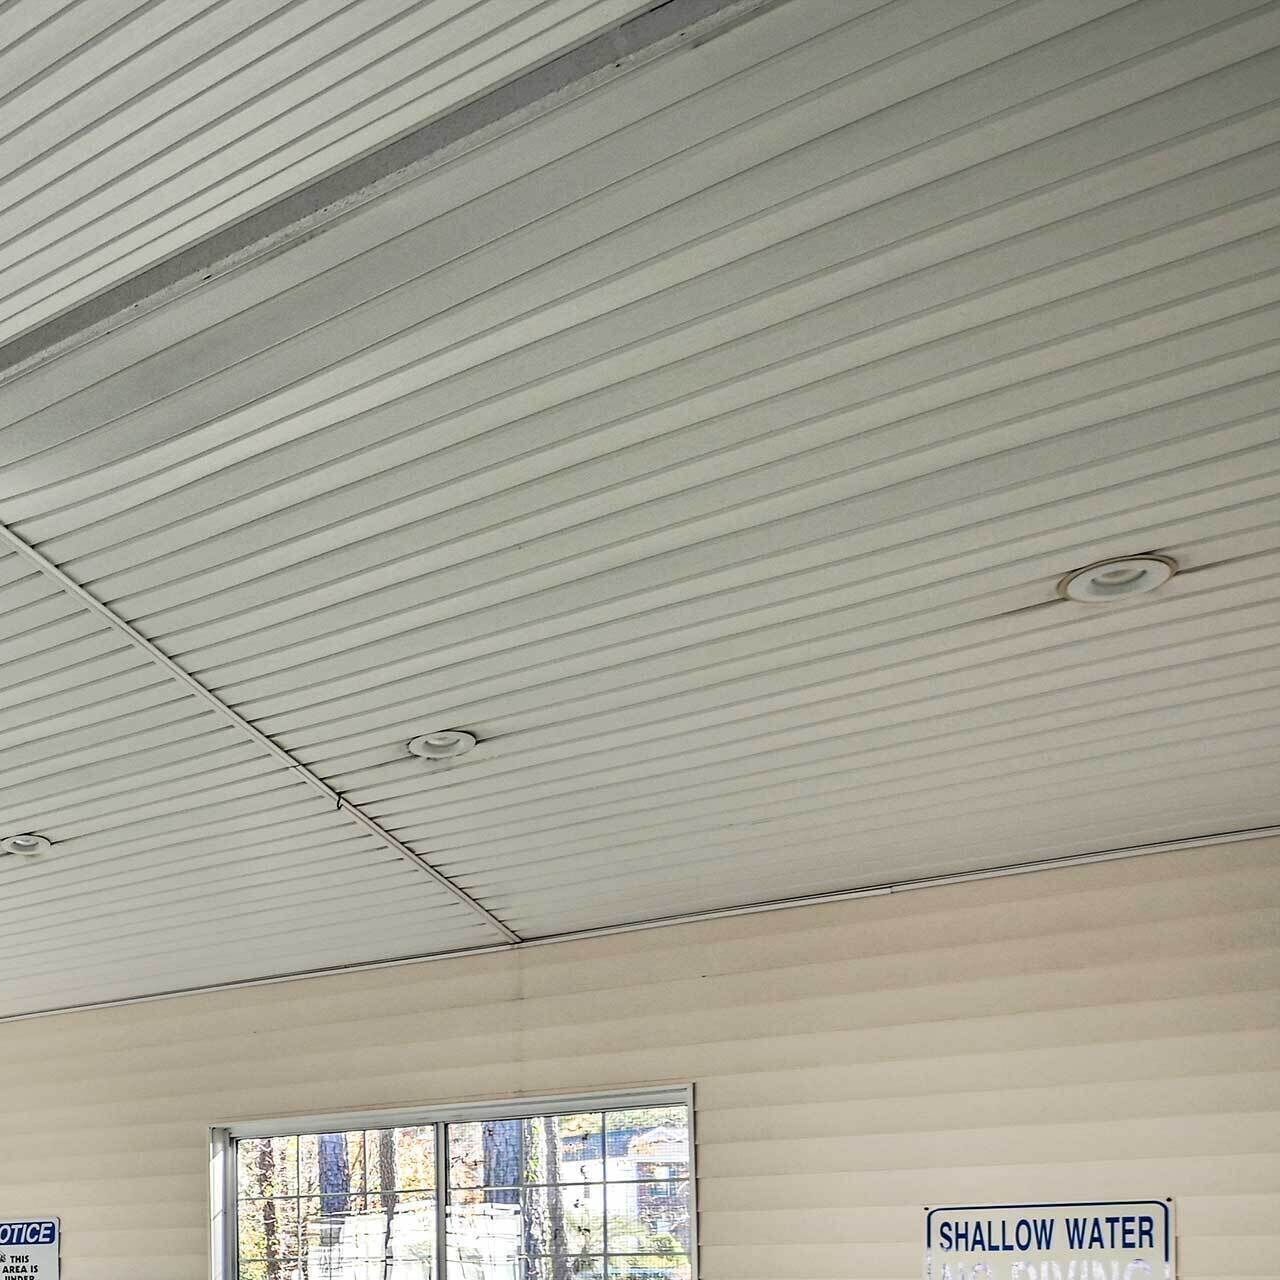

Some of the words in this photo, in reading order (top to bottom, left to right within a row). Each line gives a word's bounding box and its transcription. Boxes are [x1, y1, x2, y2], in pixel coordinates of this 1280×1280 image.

[939, 1218, 1055, 1251] SHALLOW
[1065, 1215, 1155, 1249] WATER
[10, 1255, 30, 1263] THIS
[2, 1265, 28, 1273] AREA
[30, 1264, 39, 1273] IS
